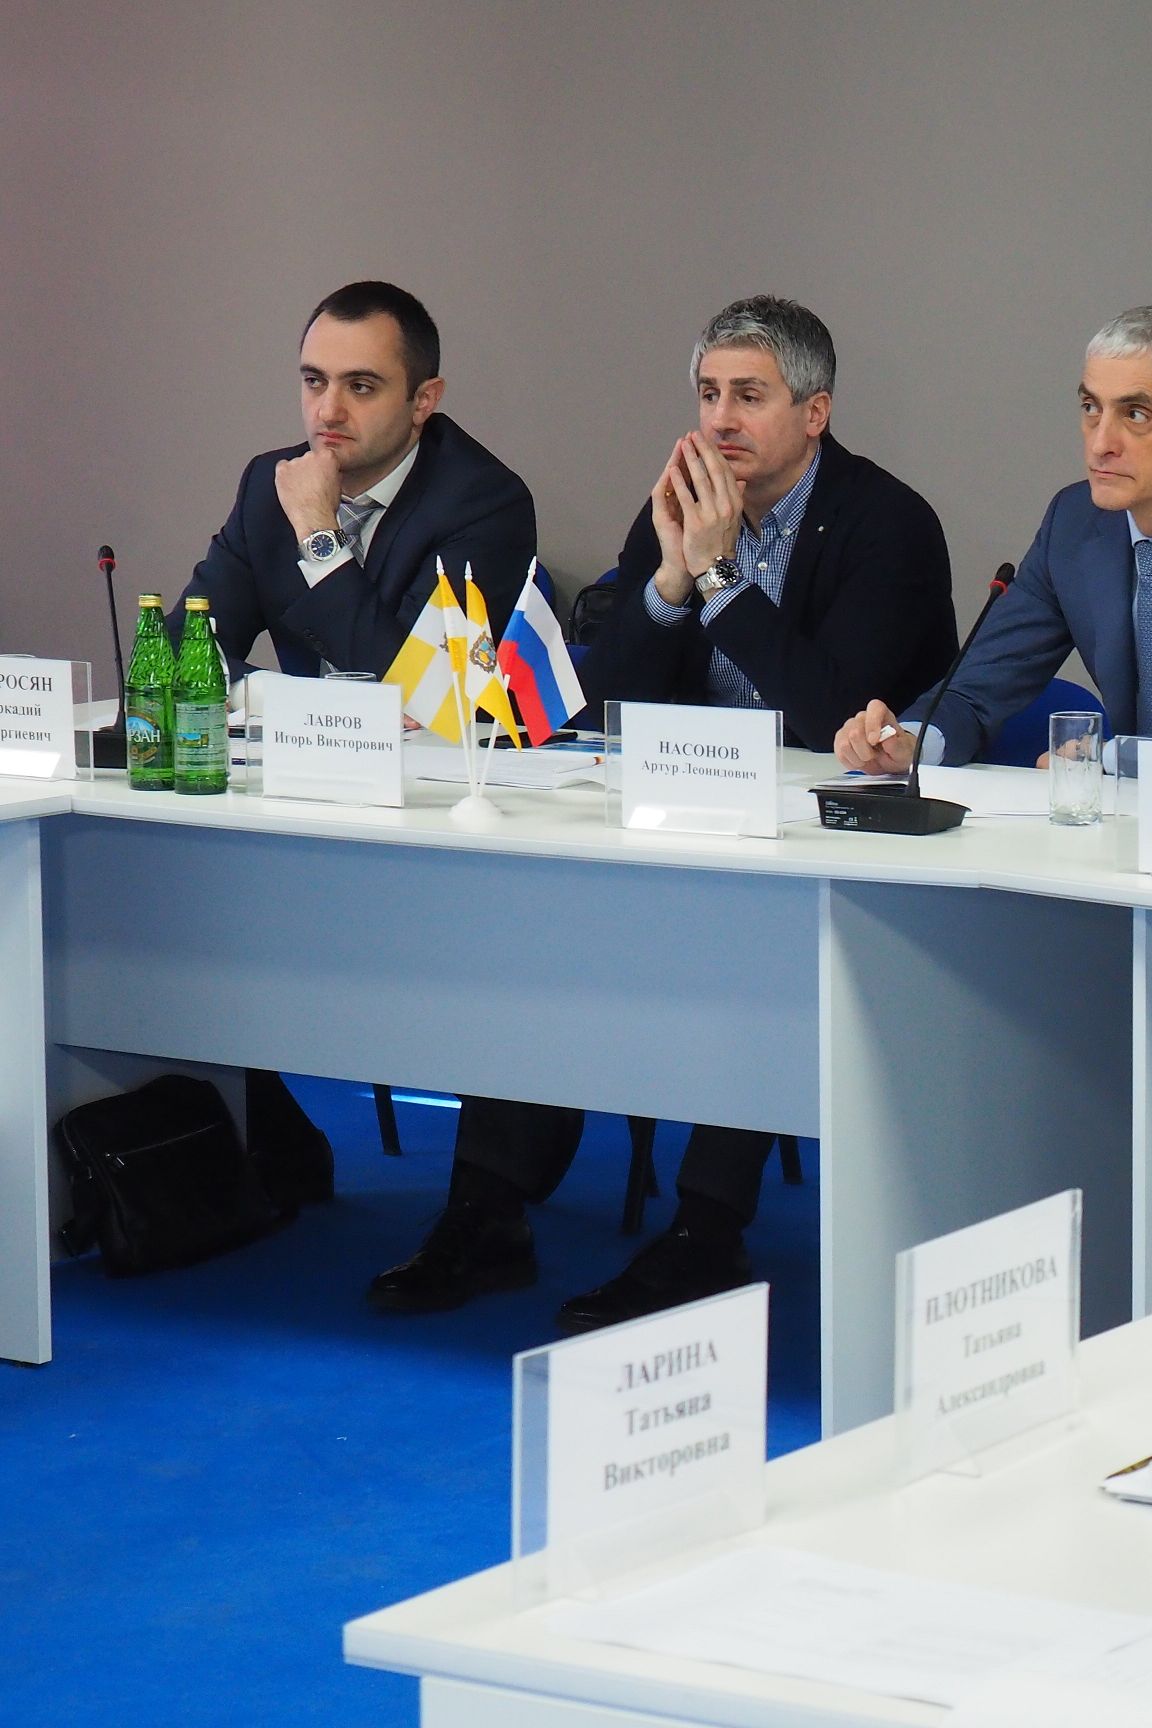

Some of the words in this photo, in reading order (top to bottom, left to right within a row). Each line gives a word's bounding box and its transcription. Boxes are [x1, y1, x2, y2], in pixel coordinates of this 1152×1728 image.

[304, 713, 362, 730] ЛАВРОВ
[275, 731, 312, 748] Игорь
[317, 734, 393, 752] Викторович
[660, 741, 740, 760] НАСОНОВ
[642, 760, 679, 776] Артур
[682, 763, 757, 780] Леонидович
[925, 1255, 1057, 1325] ПЛОТНИКОВА
[962, 1322, 1022, 1358] Татьяна
[617, 1340, 718, 1393] ЛАРИНА
[625, 1393, 712, 1436] Татьяна
[604, 1432, 731, 1491] Викторовна
